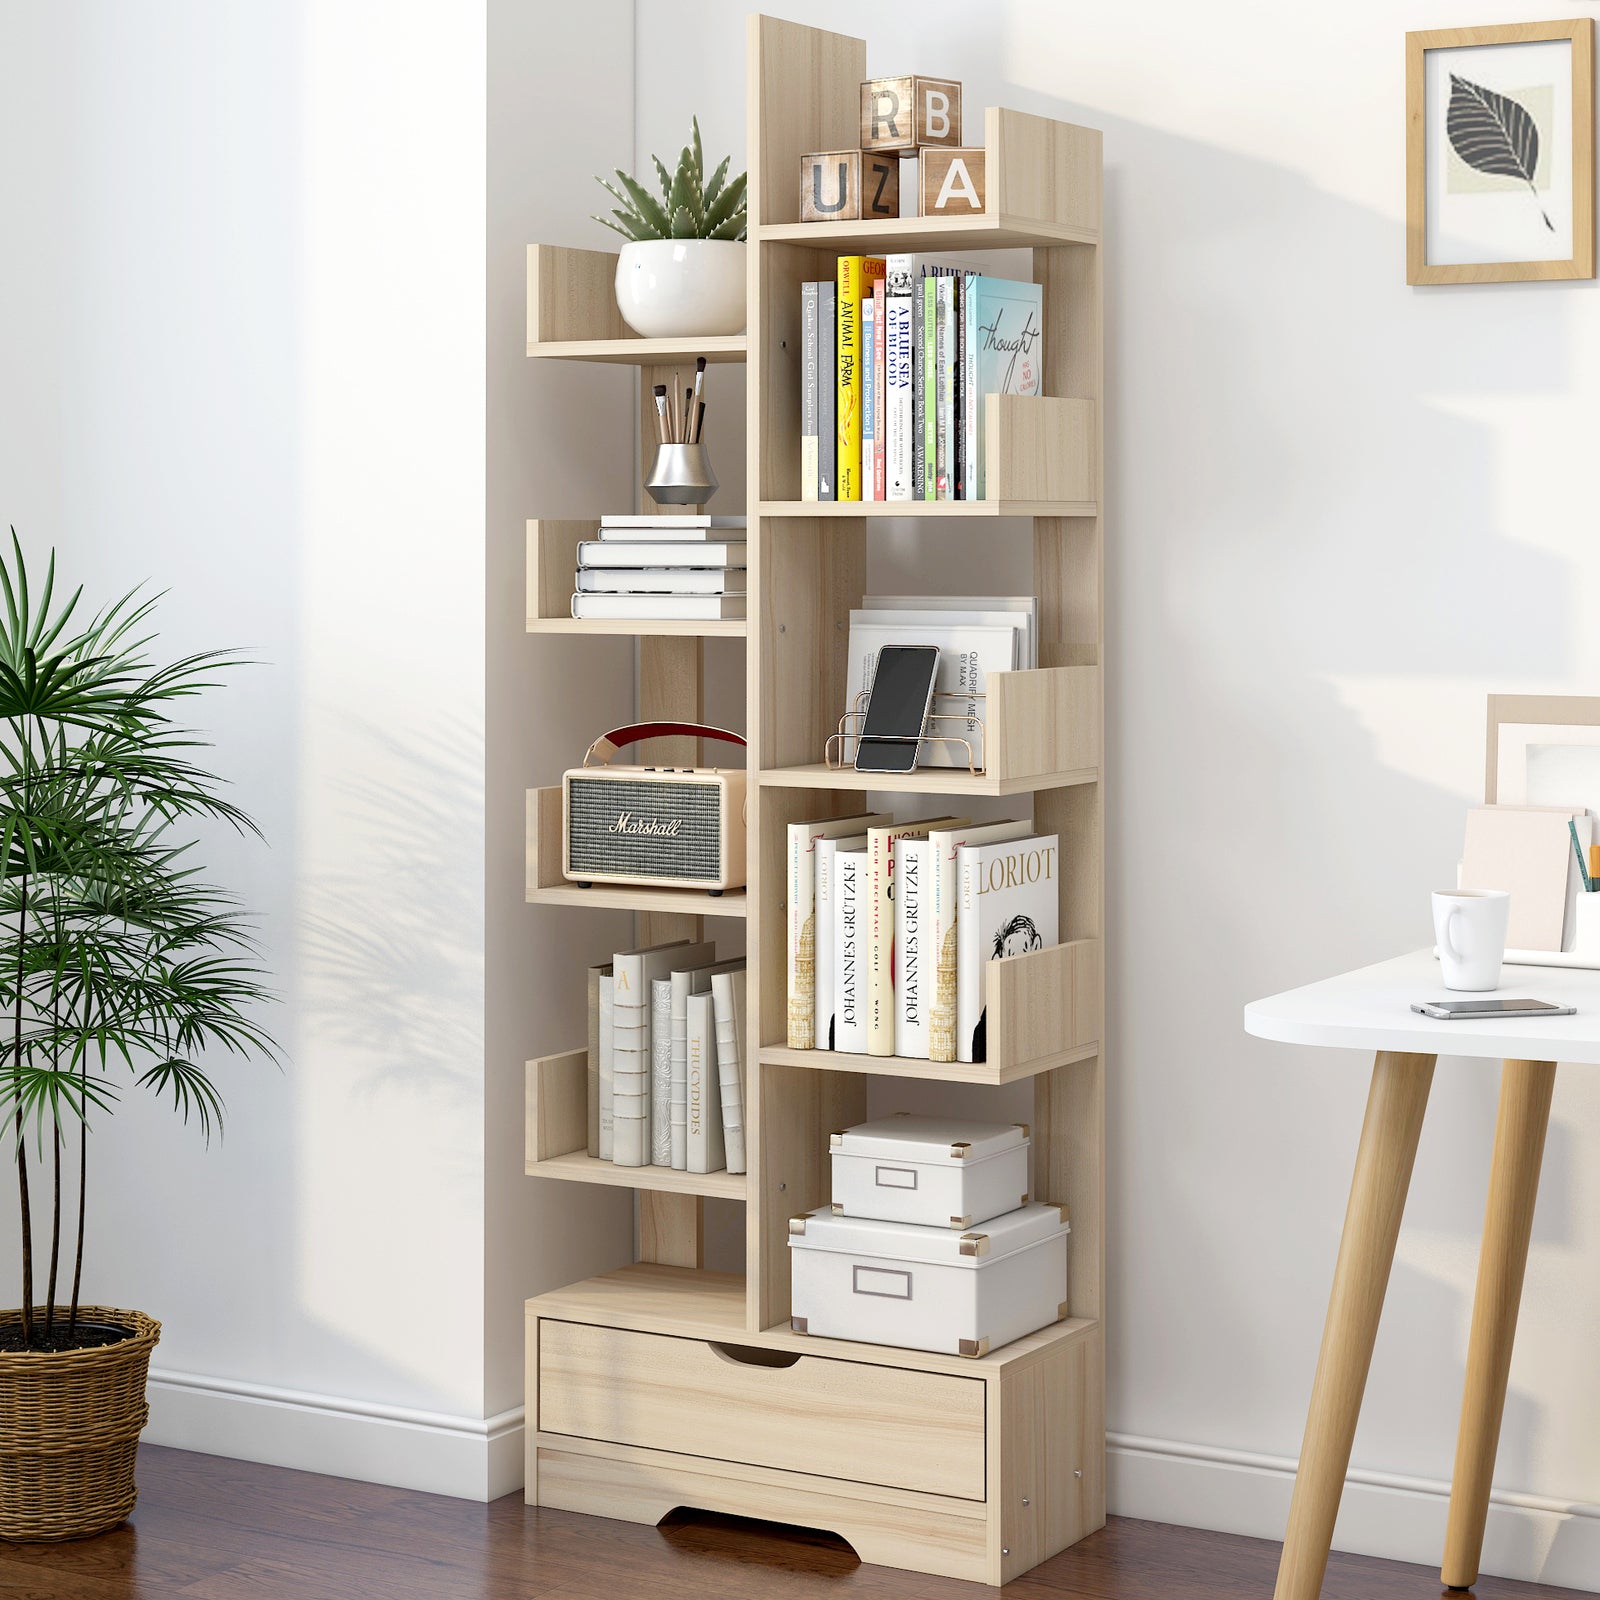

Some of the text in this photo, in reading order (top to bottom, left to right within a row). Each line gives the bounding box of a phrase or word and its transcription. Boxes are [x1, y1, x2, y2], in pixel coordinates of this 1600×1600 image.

[871, 90, 899, 139] R
[925, 89, 950, 138] B
[813, 162, 847, 213] U
[871, 163, 889, 214] Z
[934, 158, 982, 209] A
[806, 300, 815, 330] Quaker
[916, 283, 924, 298] paul
[916, 299, 924, 317] green
[807, 332, 815, 359] School
[841, 300, 853, 350] ANIMAL
[889, 310, 897, 386] OF BLOOD
[899, 306, 909, 388] A BLUE SEA
[807, 361, 815, 380] Girl
[841, 354, 855, 387] FARM
[806, 382, 815, 418] Samplers
[960, 653, 967, 664] BY
[967, 703, 976, 732] MESH
[608, 811, 682, 837] Marshall
[903, 854, 918, 934] GRÜTZKE
[976, 847, 1056, 896] LORIOT
[842, 861, 857, 1027] JOHANNES GRÜTZKE
[905, 936, 919, 1026] JOHANNES
[690, 1037, 701, 1135] THUCYDIDES
